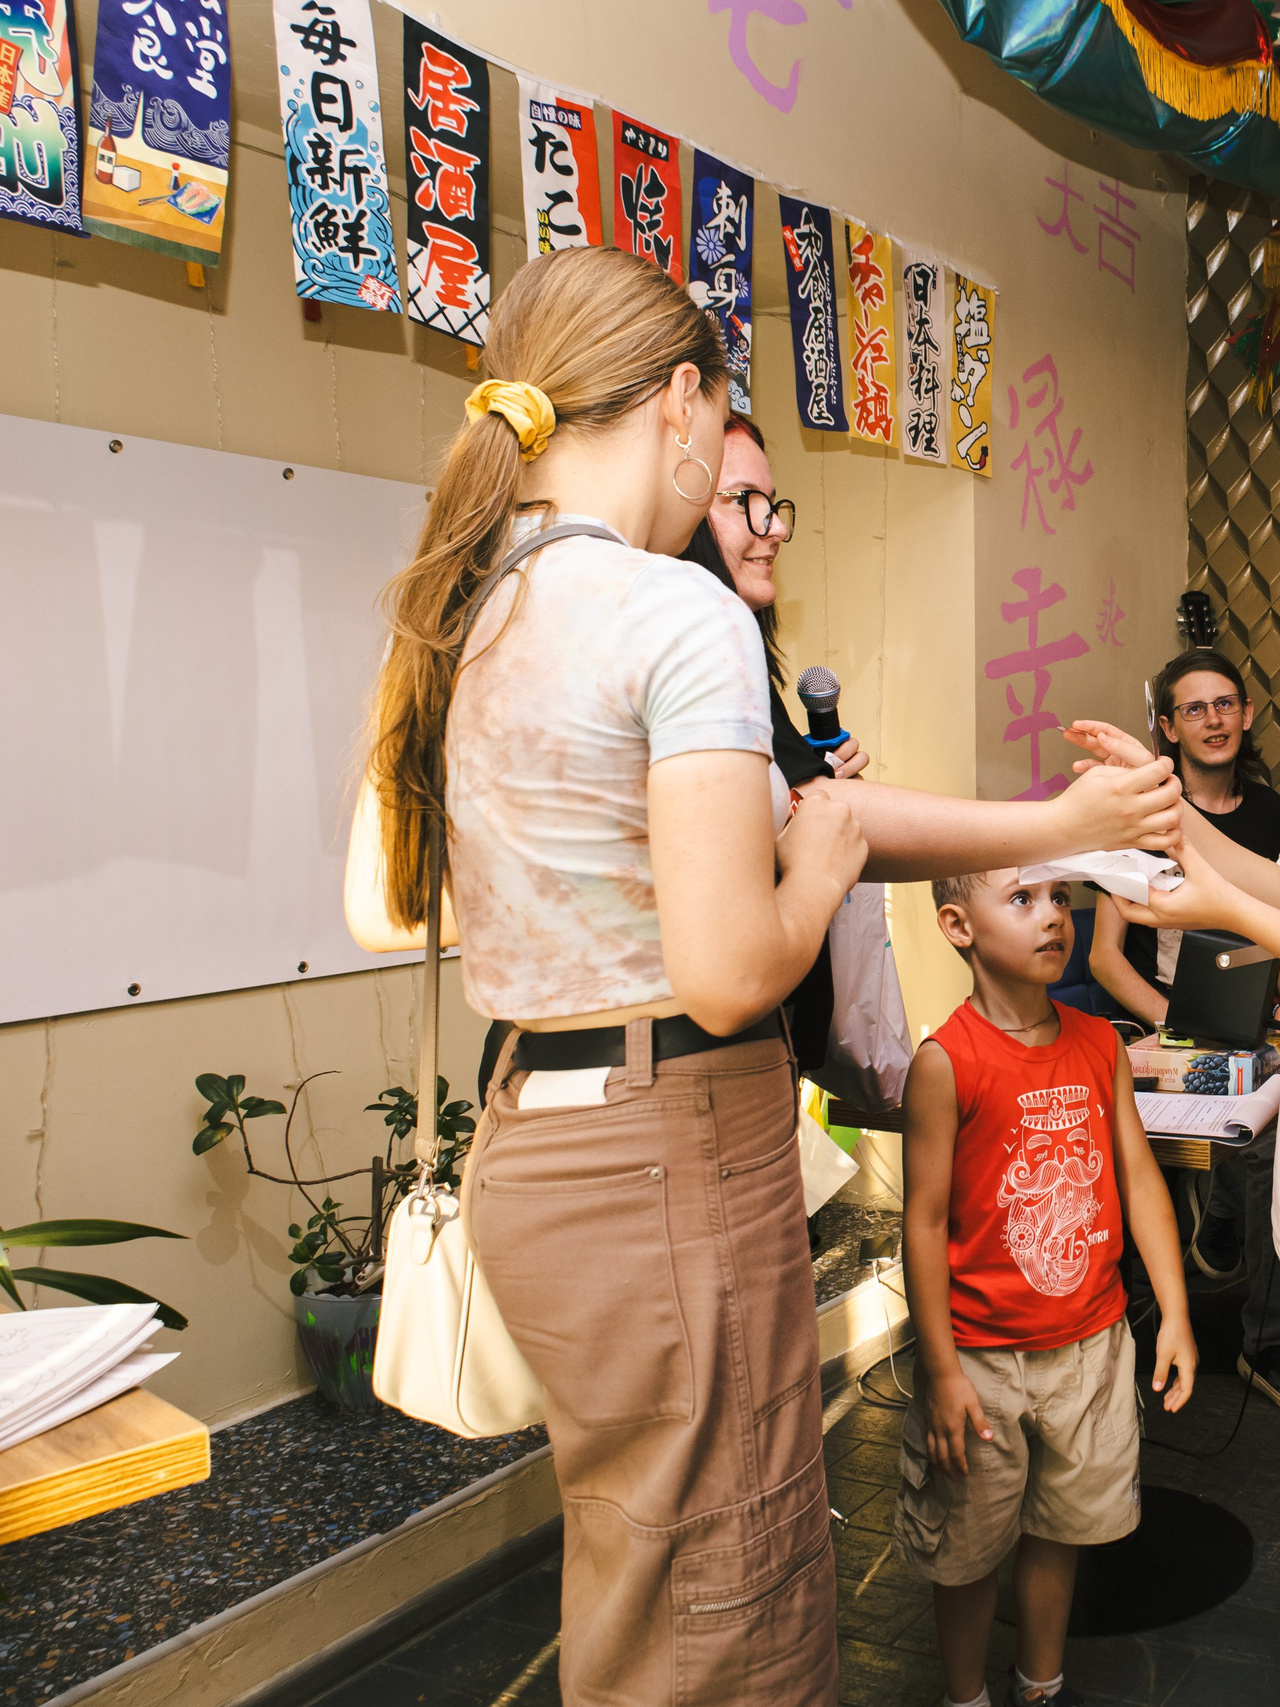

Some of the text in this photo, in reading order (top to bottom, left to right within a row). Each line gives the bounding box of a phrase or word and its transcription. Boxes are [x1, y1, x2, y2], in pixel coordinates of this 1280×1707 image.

[290, 0, 378, 272] 毎日新鮮
[407, 41, 481, 310] 居酒屋
[528, 122, 583, 251] たこ
[530, 103, 582, 129] 自慢の味
[705, 179, 748, 318] 刺身
[1036, 165, 1142, 293] 大吉
[793, 206, 835, 426] 和食居酒屋
[905, 264, 941, 458] 日本料理
[985, 567, 1090, 802] 幸
[1086, 1229, 1109, 1247] BORN
